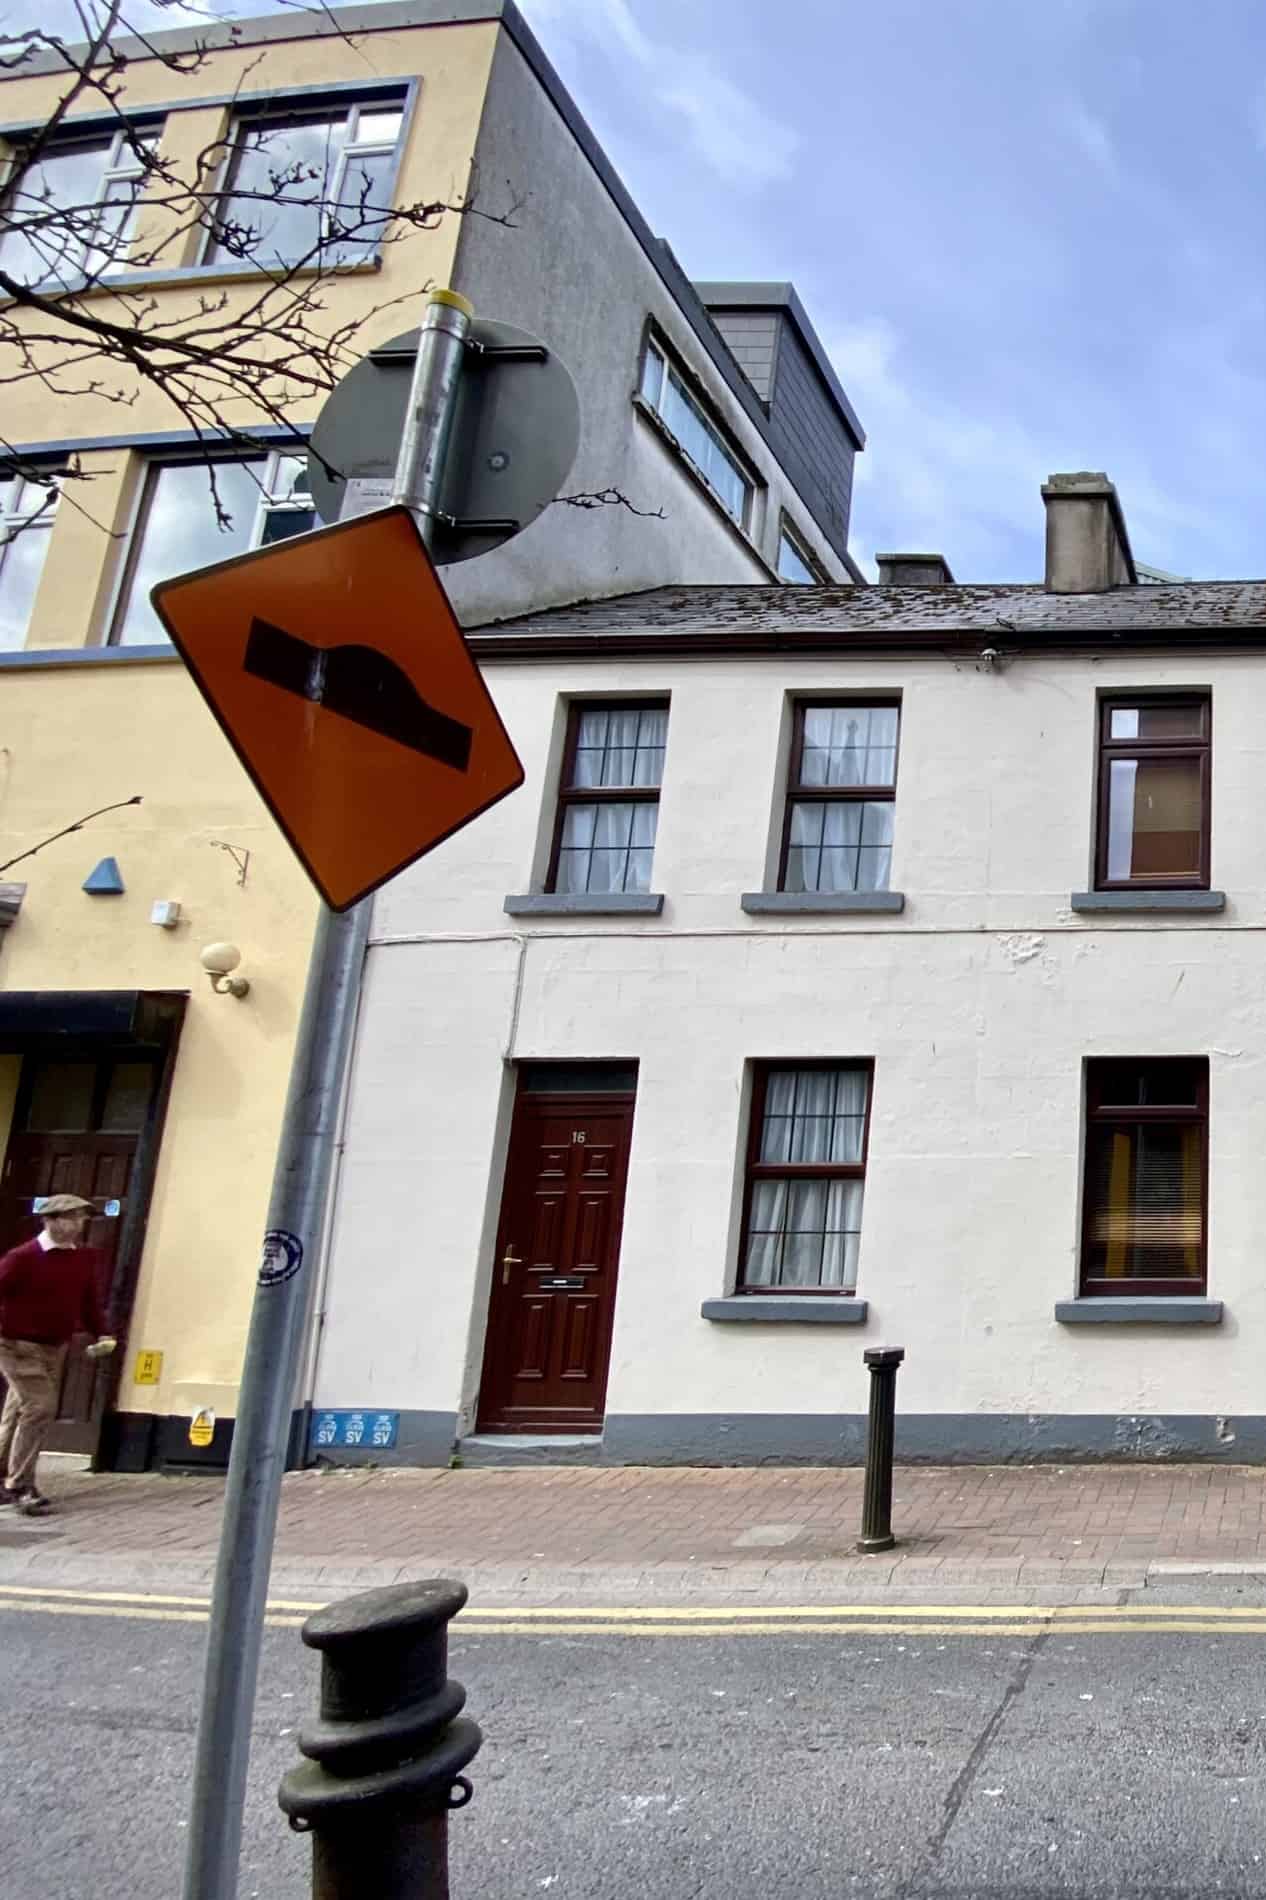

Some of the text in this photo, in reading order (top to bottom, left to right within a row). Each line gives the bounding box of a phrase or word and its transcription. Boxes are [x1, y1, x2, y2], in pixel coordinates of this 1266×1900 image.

[572, 1131, 586, 1144] 16
[144, 1359, 153, 1371] H
[318, 1431, 390, 1445] SV SV SV
